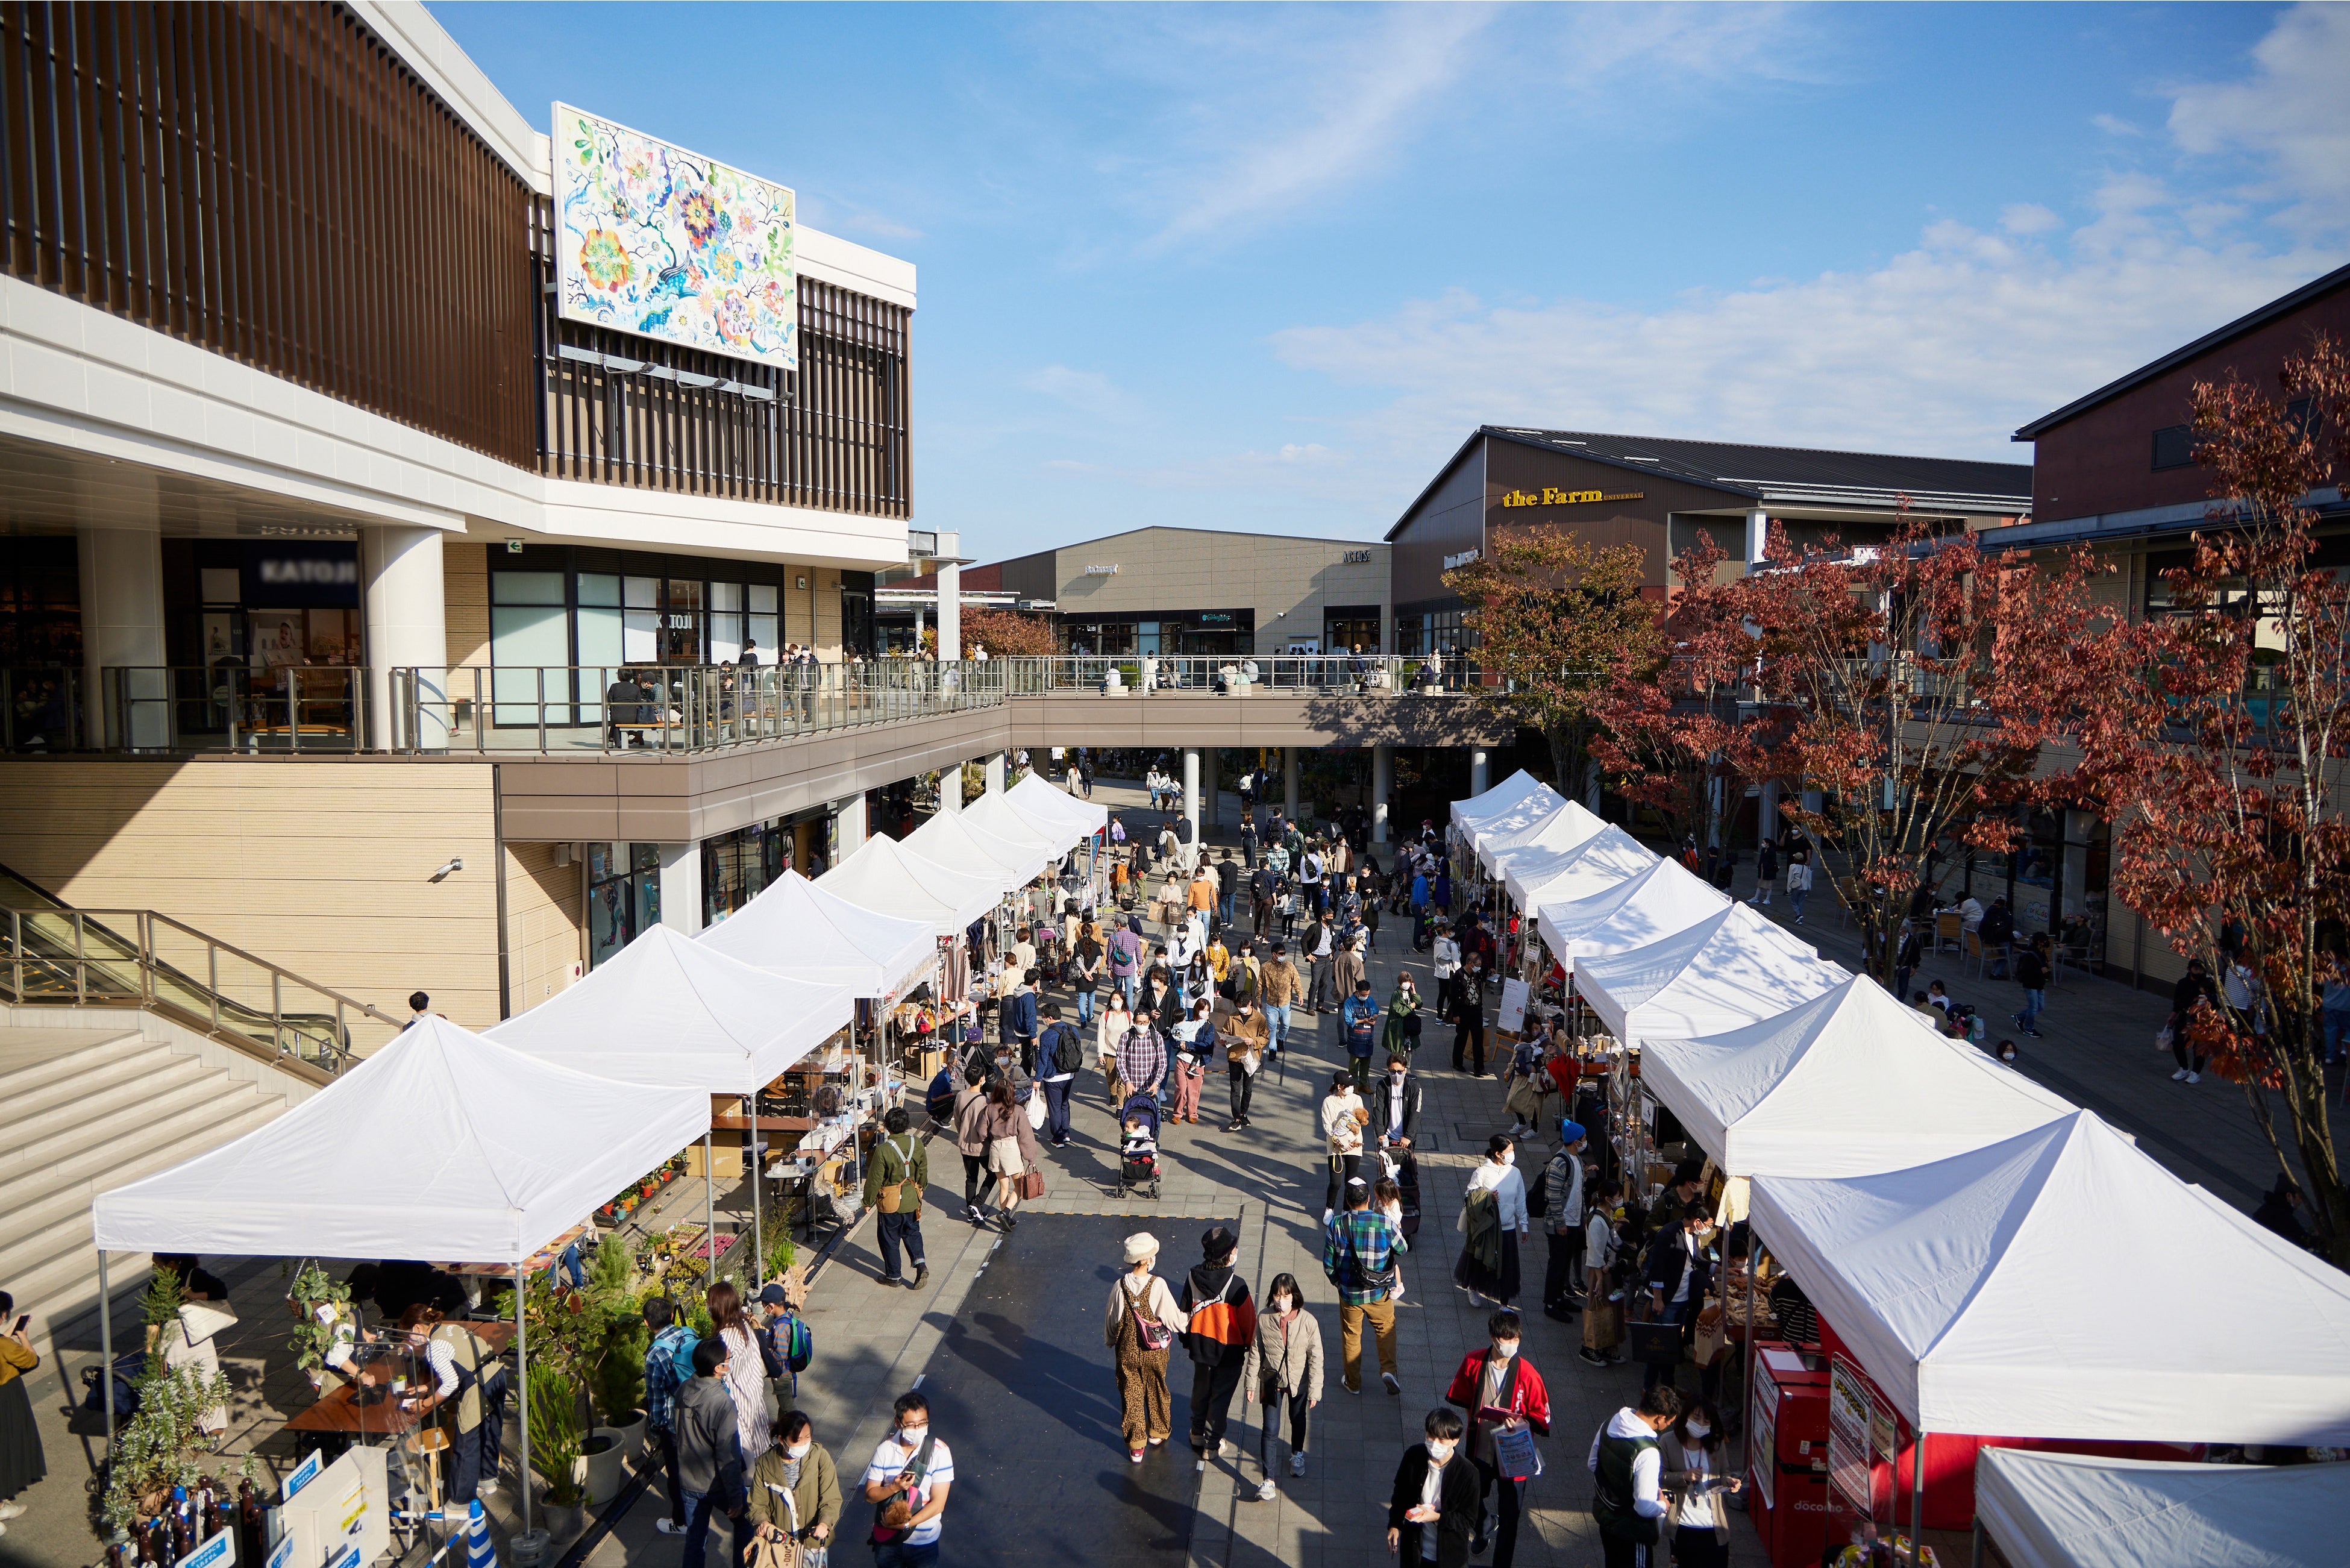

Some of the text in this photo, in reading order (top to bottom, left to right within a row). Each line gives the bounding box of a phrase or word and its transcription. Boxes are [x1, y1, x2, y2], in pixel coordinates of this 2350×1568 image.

[1502, 489, 1538, 507] the
[1541, 487, 1603, 505] Farm
[1343, 550, 1368, 563] ACTUS
[261, 560, 357, 583] KATOJI
[656, 613, 692, 629] KTOJI
[1035, 920, 1056, 928] OPEN
[1794, 1501, 1844, 1513] docomo
